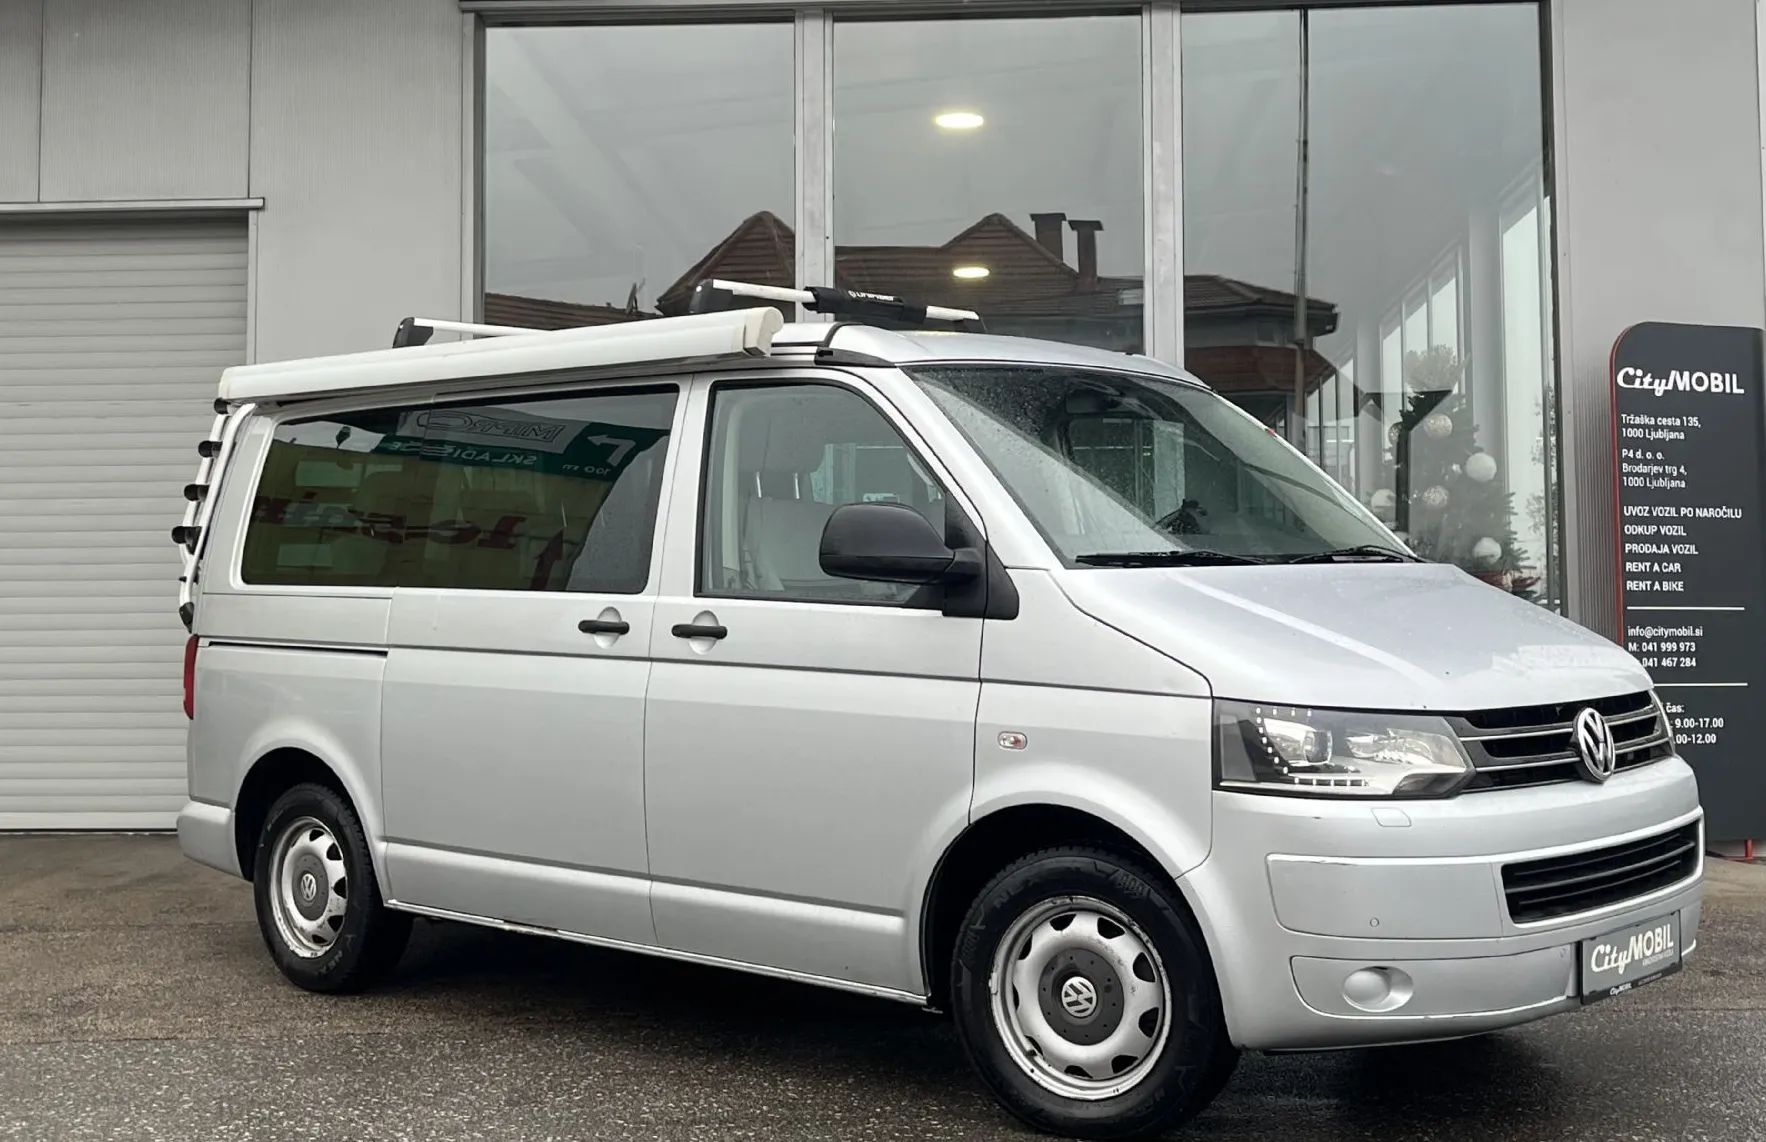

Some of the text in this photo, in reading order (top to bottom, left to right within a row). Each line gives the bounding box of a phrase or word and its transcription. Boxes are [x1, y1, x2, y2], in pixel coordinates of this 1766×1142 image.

[1617, 367, 1745, 396] CityMOBIL
[1621, 414, 1701, 428] Tržaška cesta 135,
[1622, 428, 1685, 441] 1000 Ljubljana
[1622, 449, 1665, 460] P4 d. o. o.
[1622, 463, 1688, 476] Brodarjev trg 4,
[1623, 477, 1686, 490] 1000 Ljubljana
[1623, 505, 1742, 518] UVOZ VOZIL PO NAROČILU
[1624, 525, 1687, 536] ODKUP VOZIL
[1625, 544, 1699, 555] PRODAJA VOZIL
[1625, 562, 1682, 573] RENT A CAR
[1626, 581, 1684, 592] RENT A BIKE
[1627, 625, 1703, 639] info@citymobil.si
[1628, 642, 1696, 652] M: 041 999 973
[1642, 657, 1697, 667] 041 467 284
[1665, 702, 1685, 713] čas:
[1674, 717, 1724, 728] 9.00-17.00
[1673, 733, 1717, 744] .00-12.00
[1591, 923, 1674, 975] CityMOBIL
